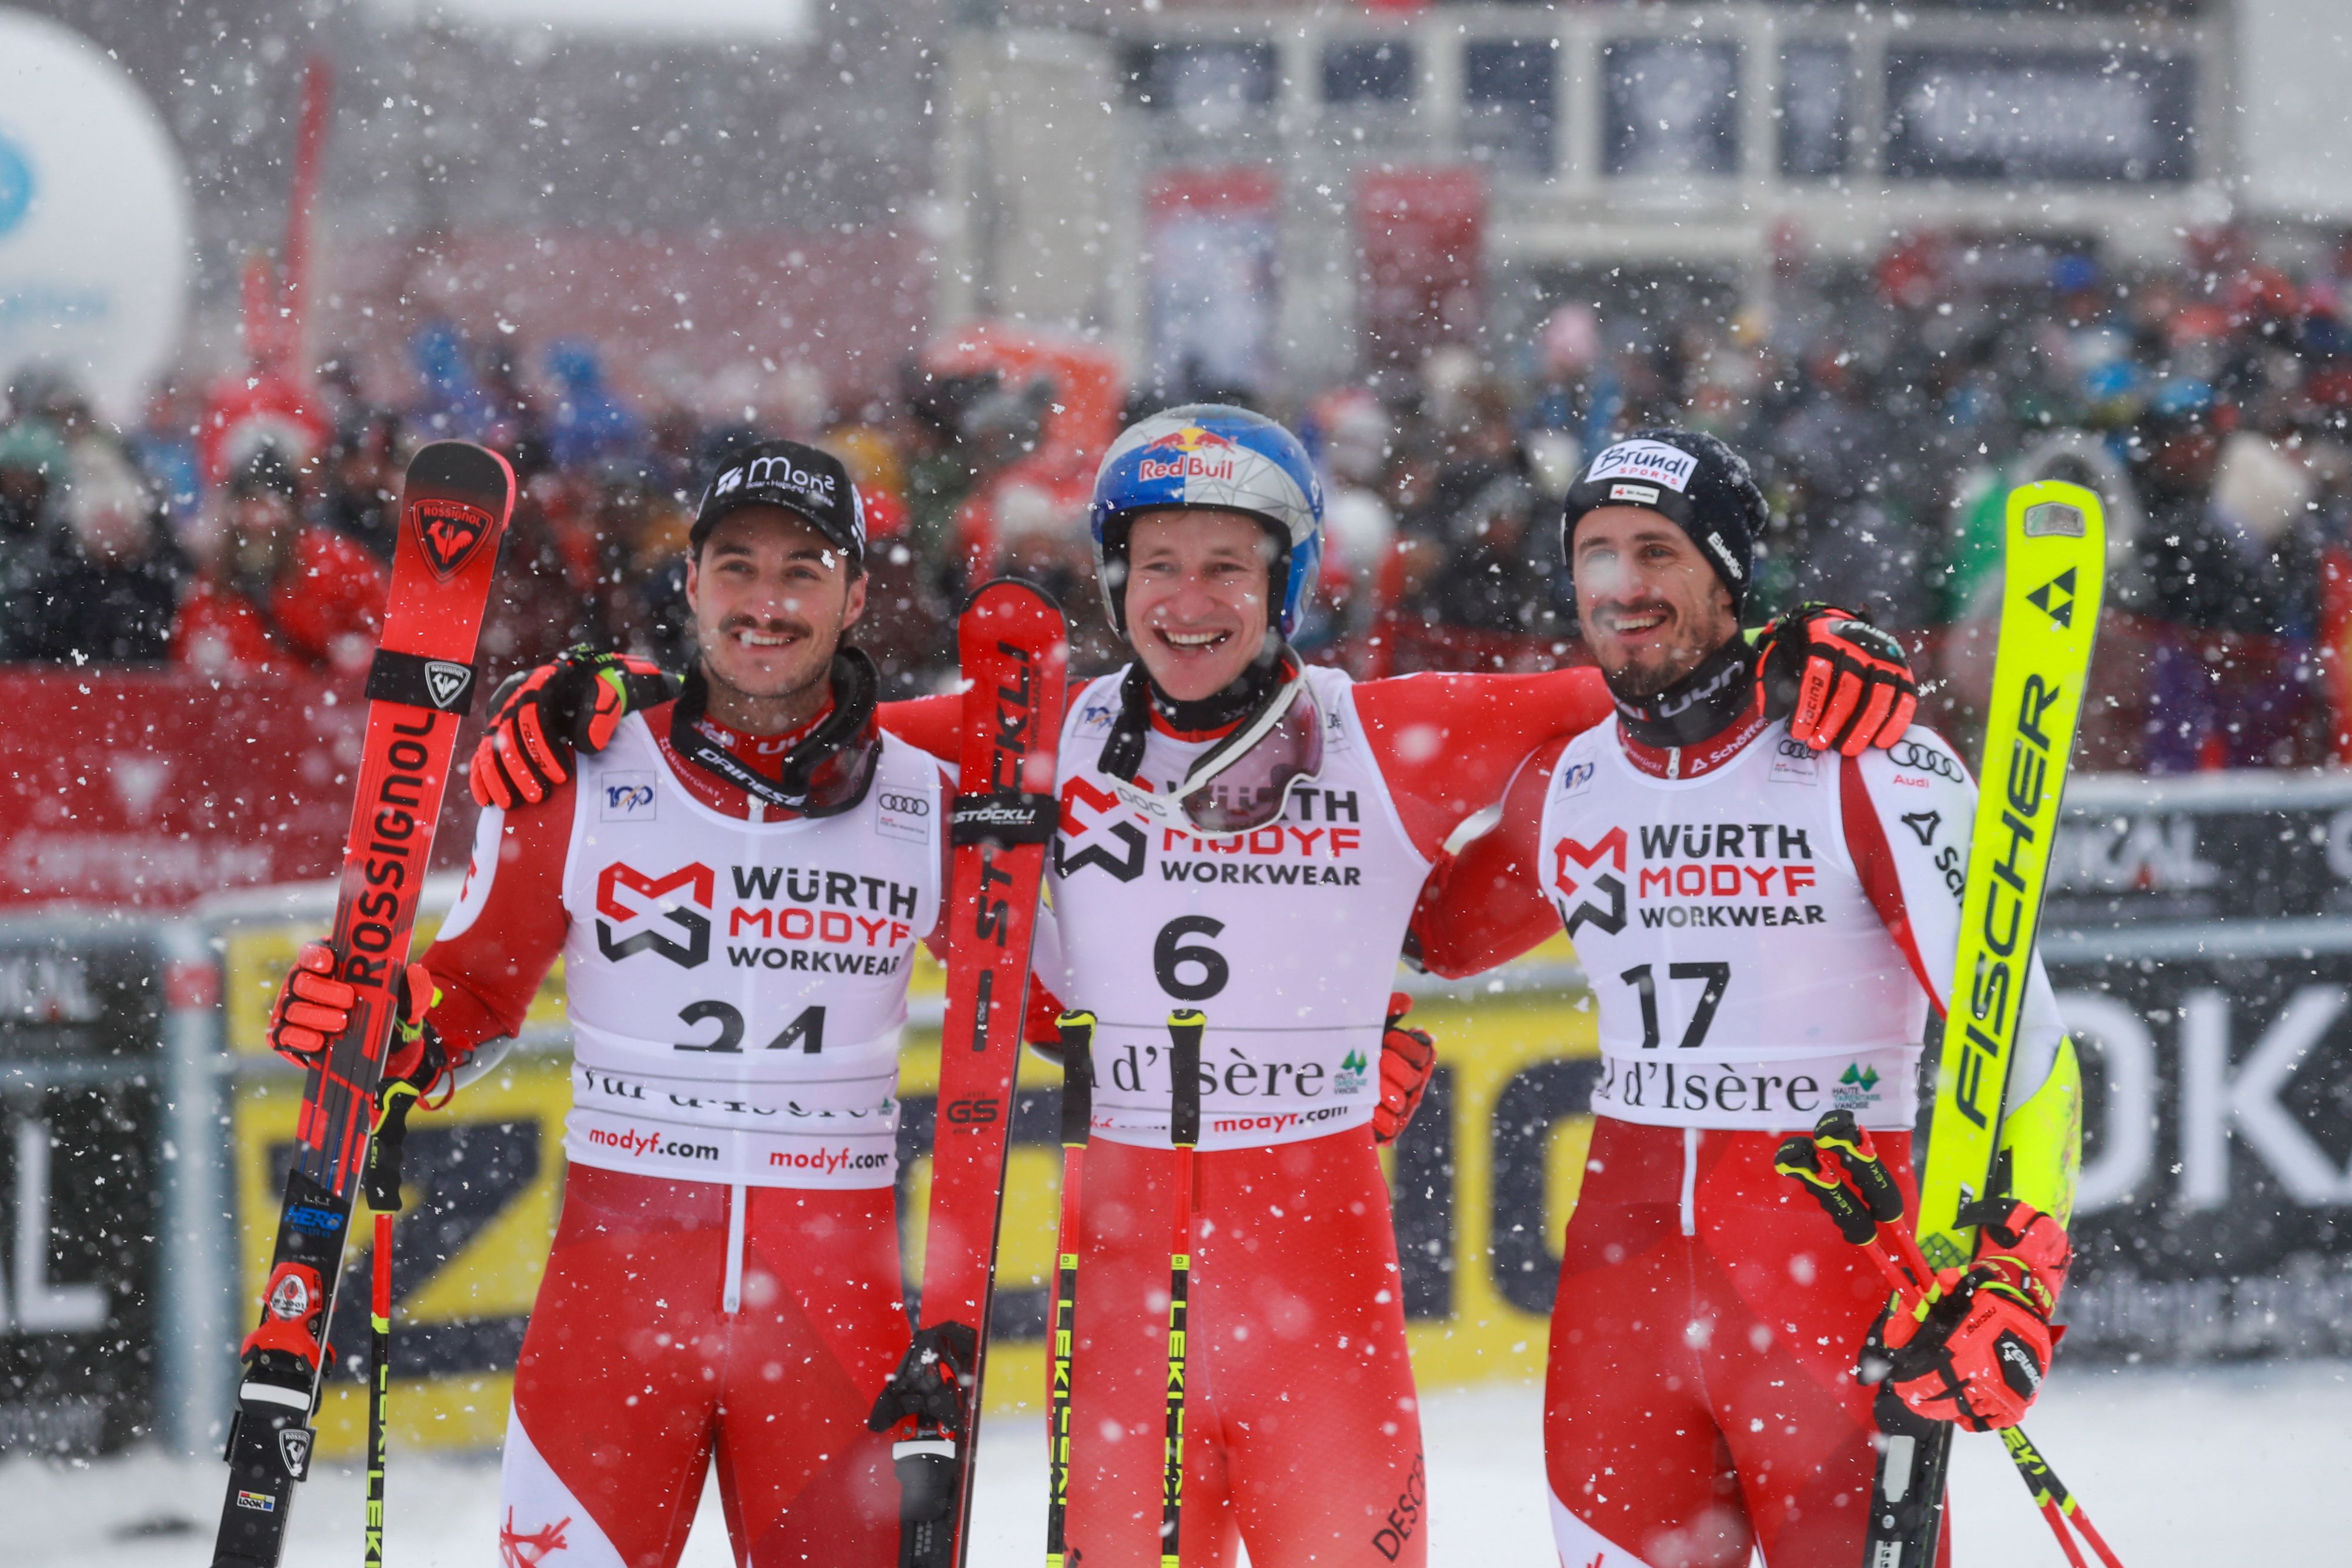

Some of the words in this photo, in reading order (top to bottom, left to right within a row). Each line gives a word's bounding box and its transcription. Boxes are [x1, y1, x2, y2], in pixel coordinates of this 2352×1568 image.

[1138, 456, 1186, 482] Red
[1187, 456, 1234, 480] Bull
[1619, 467, 1678, 485] SPORTS
[1893, 774, 1930, 788] Audi
[954, 807, 1036, 824] STÖCKLI
[345, 711, 436, 988] ROSSIGNOL
[1162, 823, 1361, 858] MODYF
[1639, 823, 1813, 860] WÜRTH
[1161, 860, 1361, 886] WORKWEAR
[1639, 863, 1816, 898] MODYF
[731, 865, 918, 920] WÜRTH
[1956, 674, 2061, 1131] FISCHER
[729, 906, 911, 948] MODYF
[1639, 904, 1828, 928] WORKWEAR
[727, 947, 901, 977] WORKWEAR
[1153, 915, 1230, 1002] 6
[1620, 961, 1731, 1049] 17
[673, 999, 826, 1054] 24
[947, 1099, 999, 1124] GS
[370, 1136, 379, 1169] LEKI
[589, 1128, 719, 1161] modyf.com
[770, 1148, 889, 1174] modyf.com
[1869, 1163, 1888, 1189] LEKI
[283, 1205, 344, 1231] HERO
[1829, 1189, 1853, 1215] LEKI
[1053, 1299, 1073, 1399] LEKI
[1167, 1300, 1187, 1400] LEKI
[238, 1497, 263, 1509] LOOK
[364, 1470, 384, 1568] LEKI
